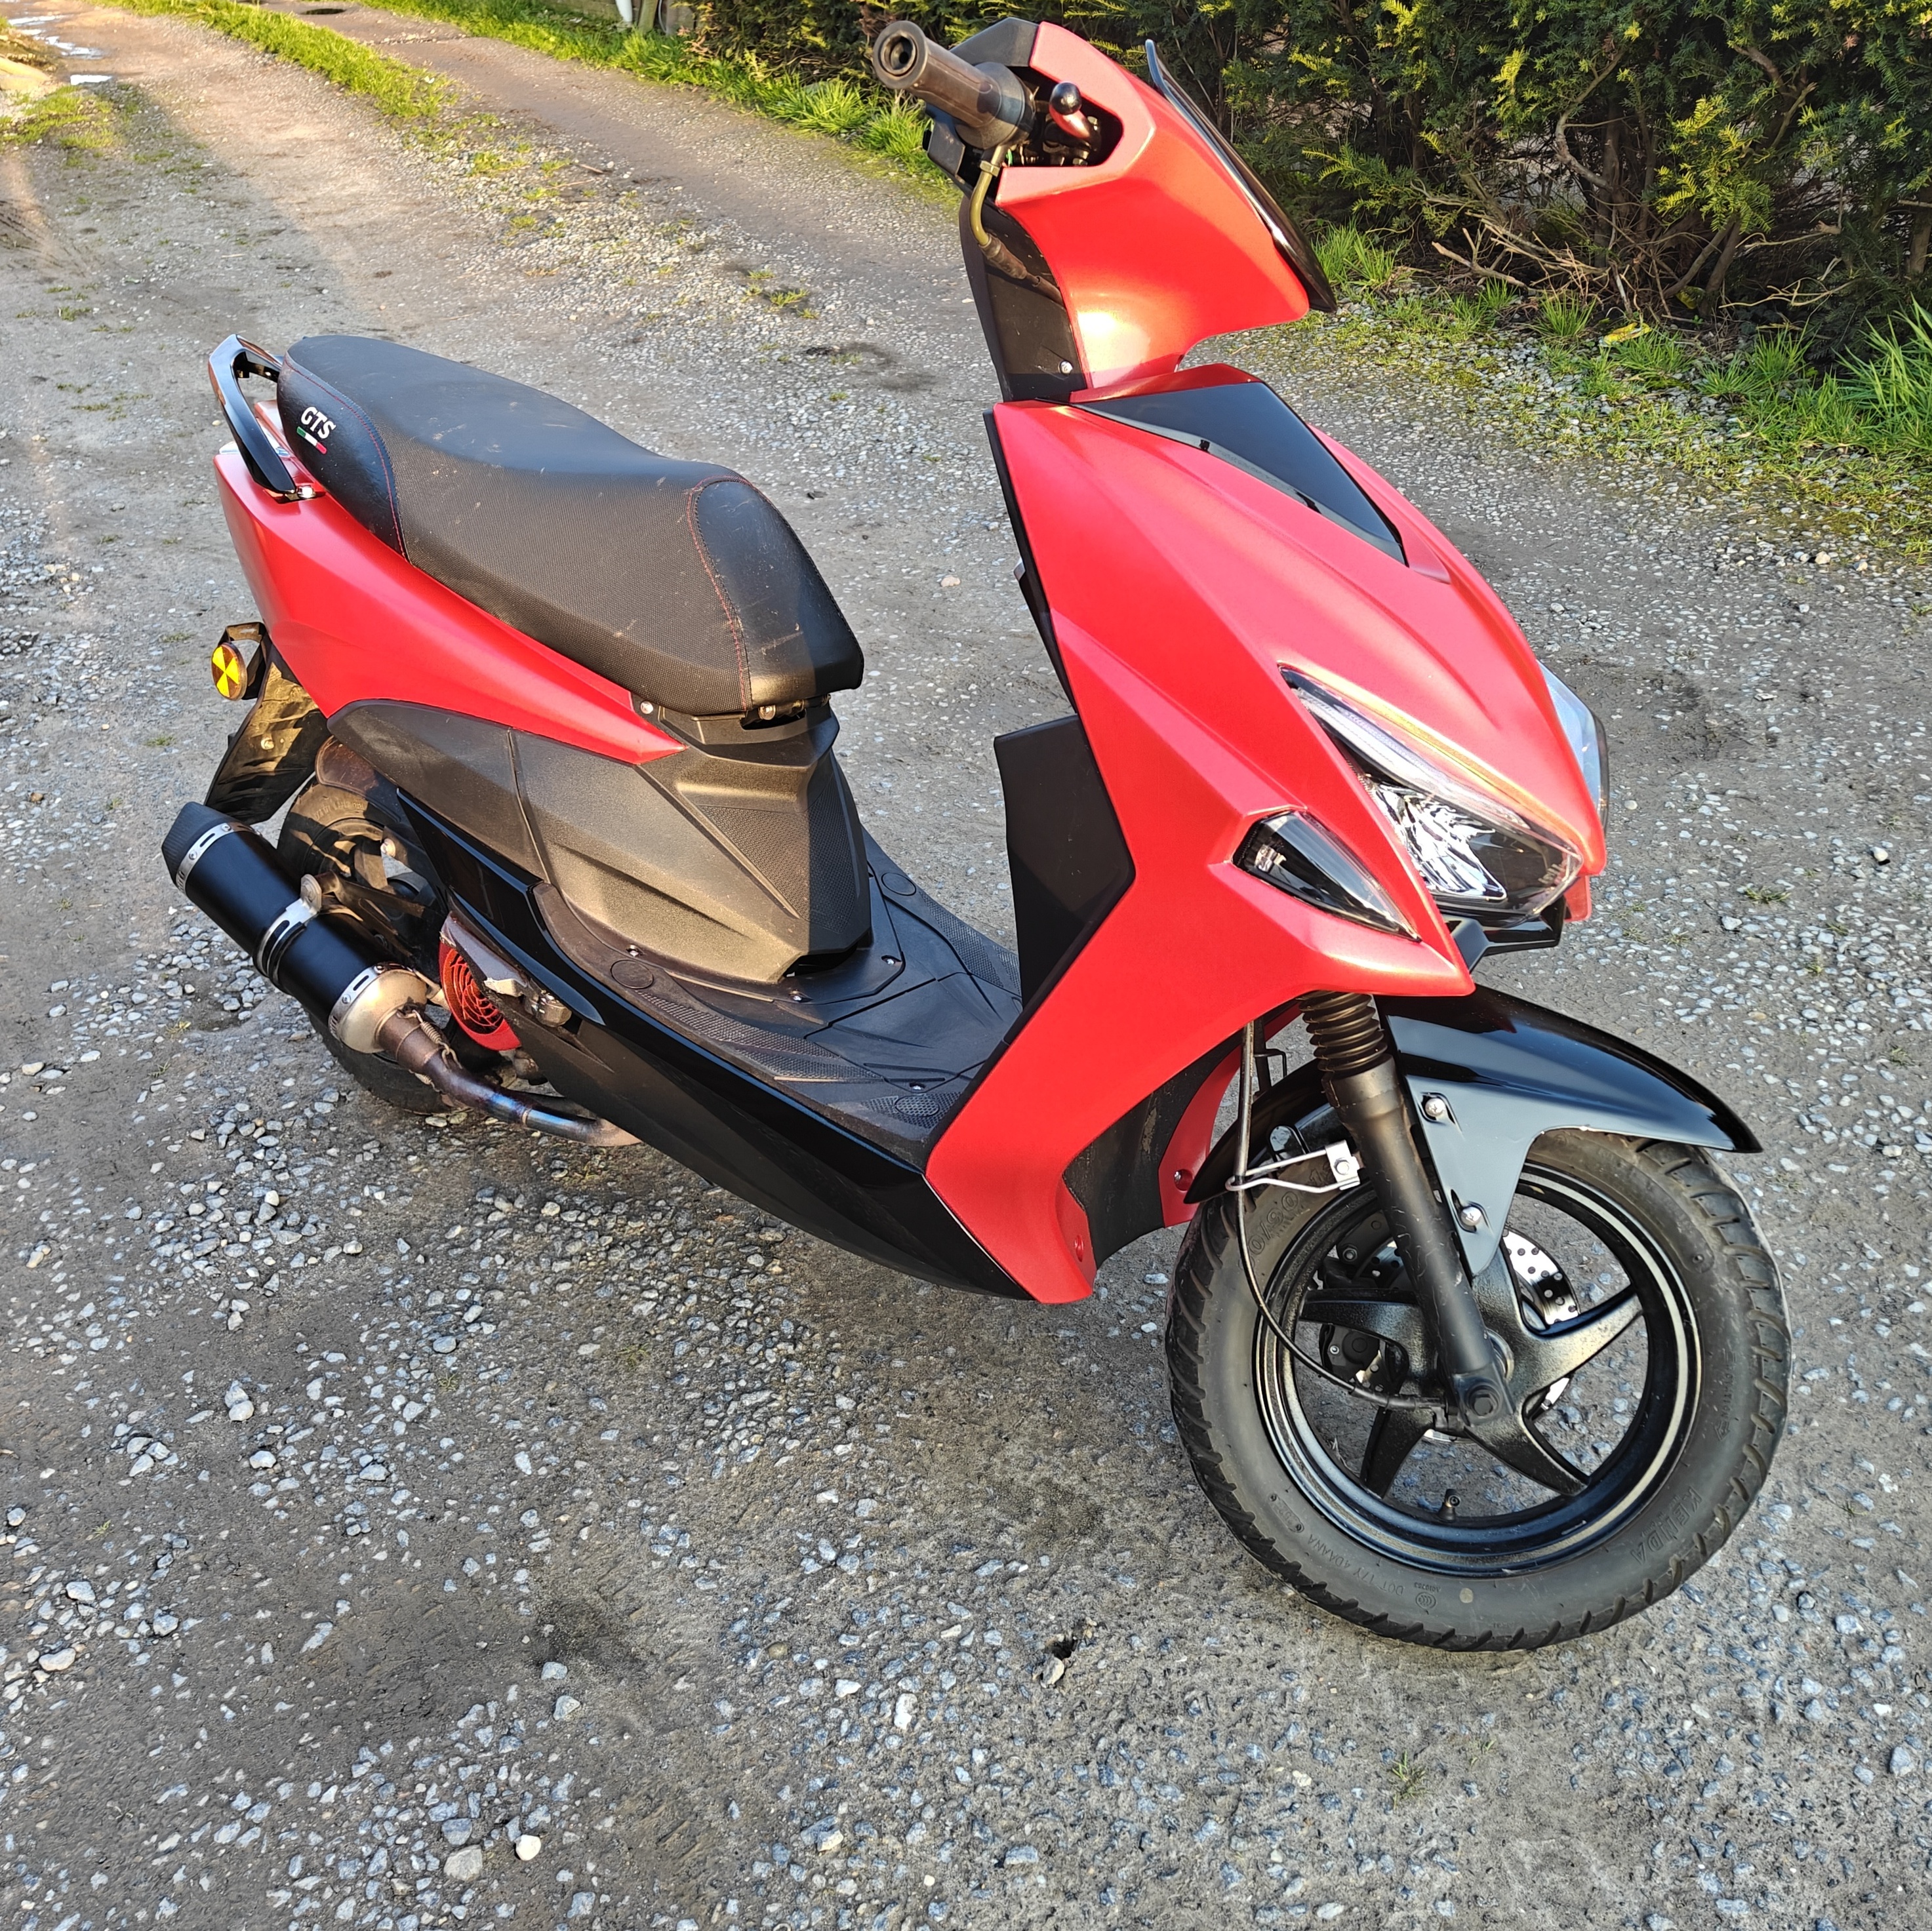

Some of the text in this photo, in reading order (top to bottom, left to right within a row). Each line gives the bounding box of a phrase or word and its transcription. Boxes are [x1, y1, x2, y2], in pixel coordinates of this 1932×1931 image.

[300, 407, 336, 439] GTS
[1630, 1486, 1702, 1564] KENDA
[1379, 1581, 1404, 1596] DOT
